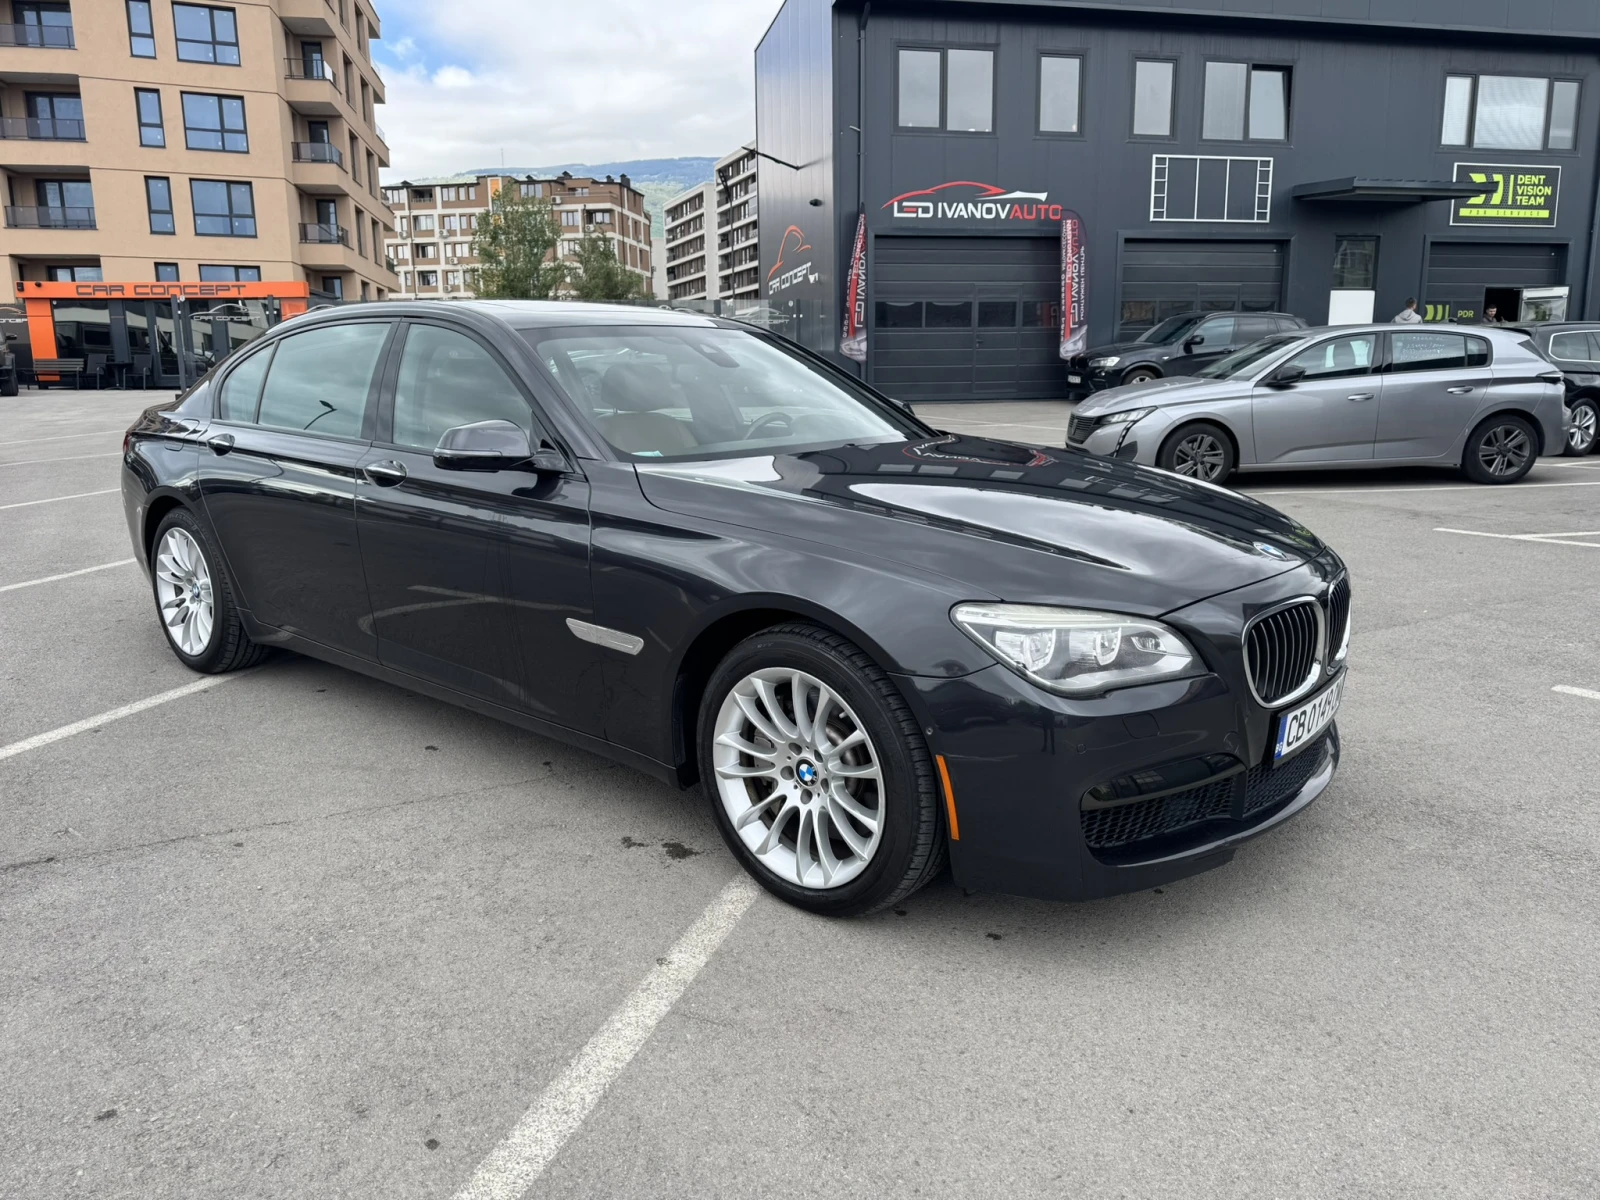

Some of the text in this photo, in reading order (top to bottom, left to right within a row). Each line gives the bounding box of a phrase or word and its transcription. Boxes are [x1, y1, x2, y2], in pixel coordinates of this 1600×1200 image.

[1517, 174, 1546, 185] DENT
[1516, 185, 1552, 195] VISION
[1516, 196, 1545, 206] TEAM
[893, 201, 933, 218] LED
[76, 284, 246, 296] CAR CONCEPT
[1457, 310, 1474, 318] PDR
